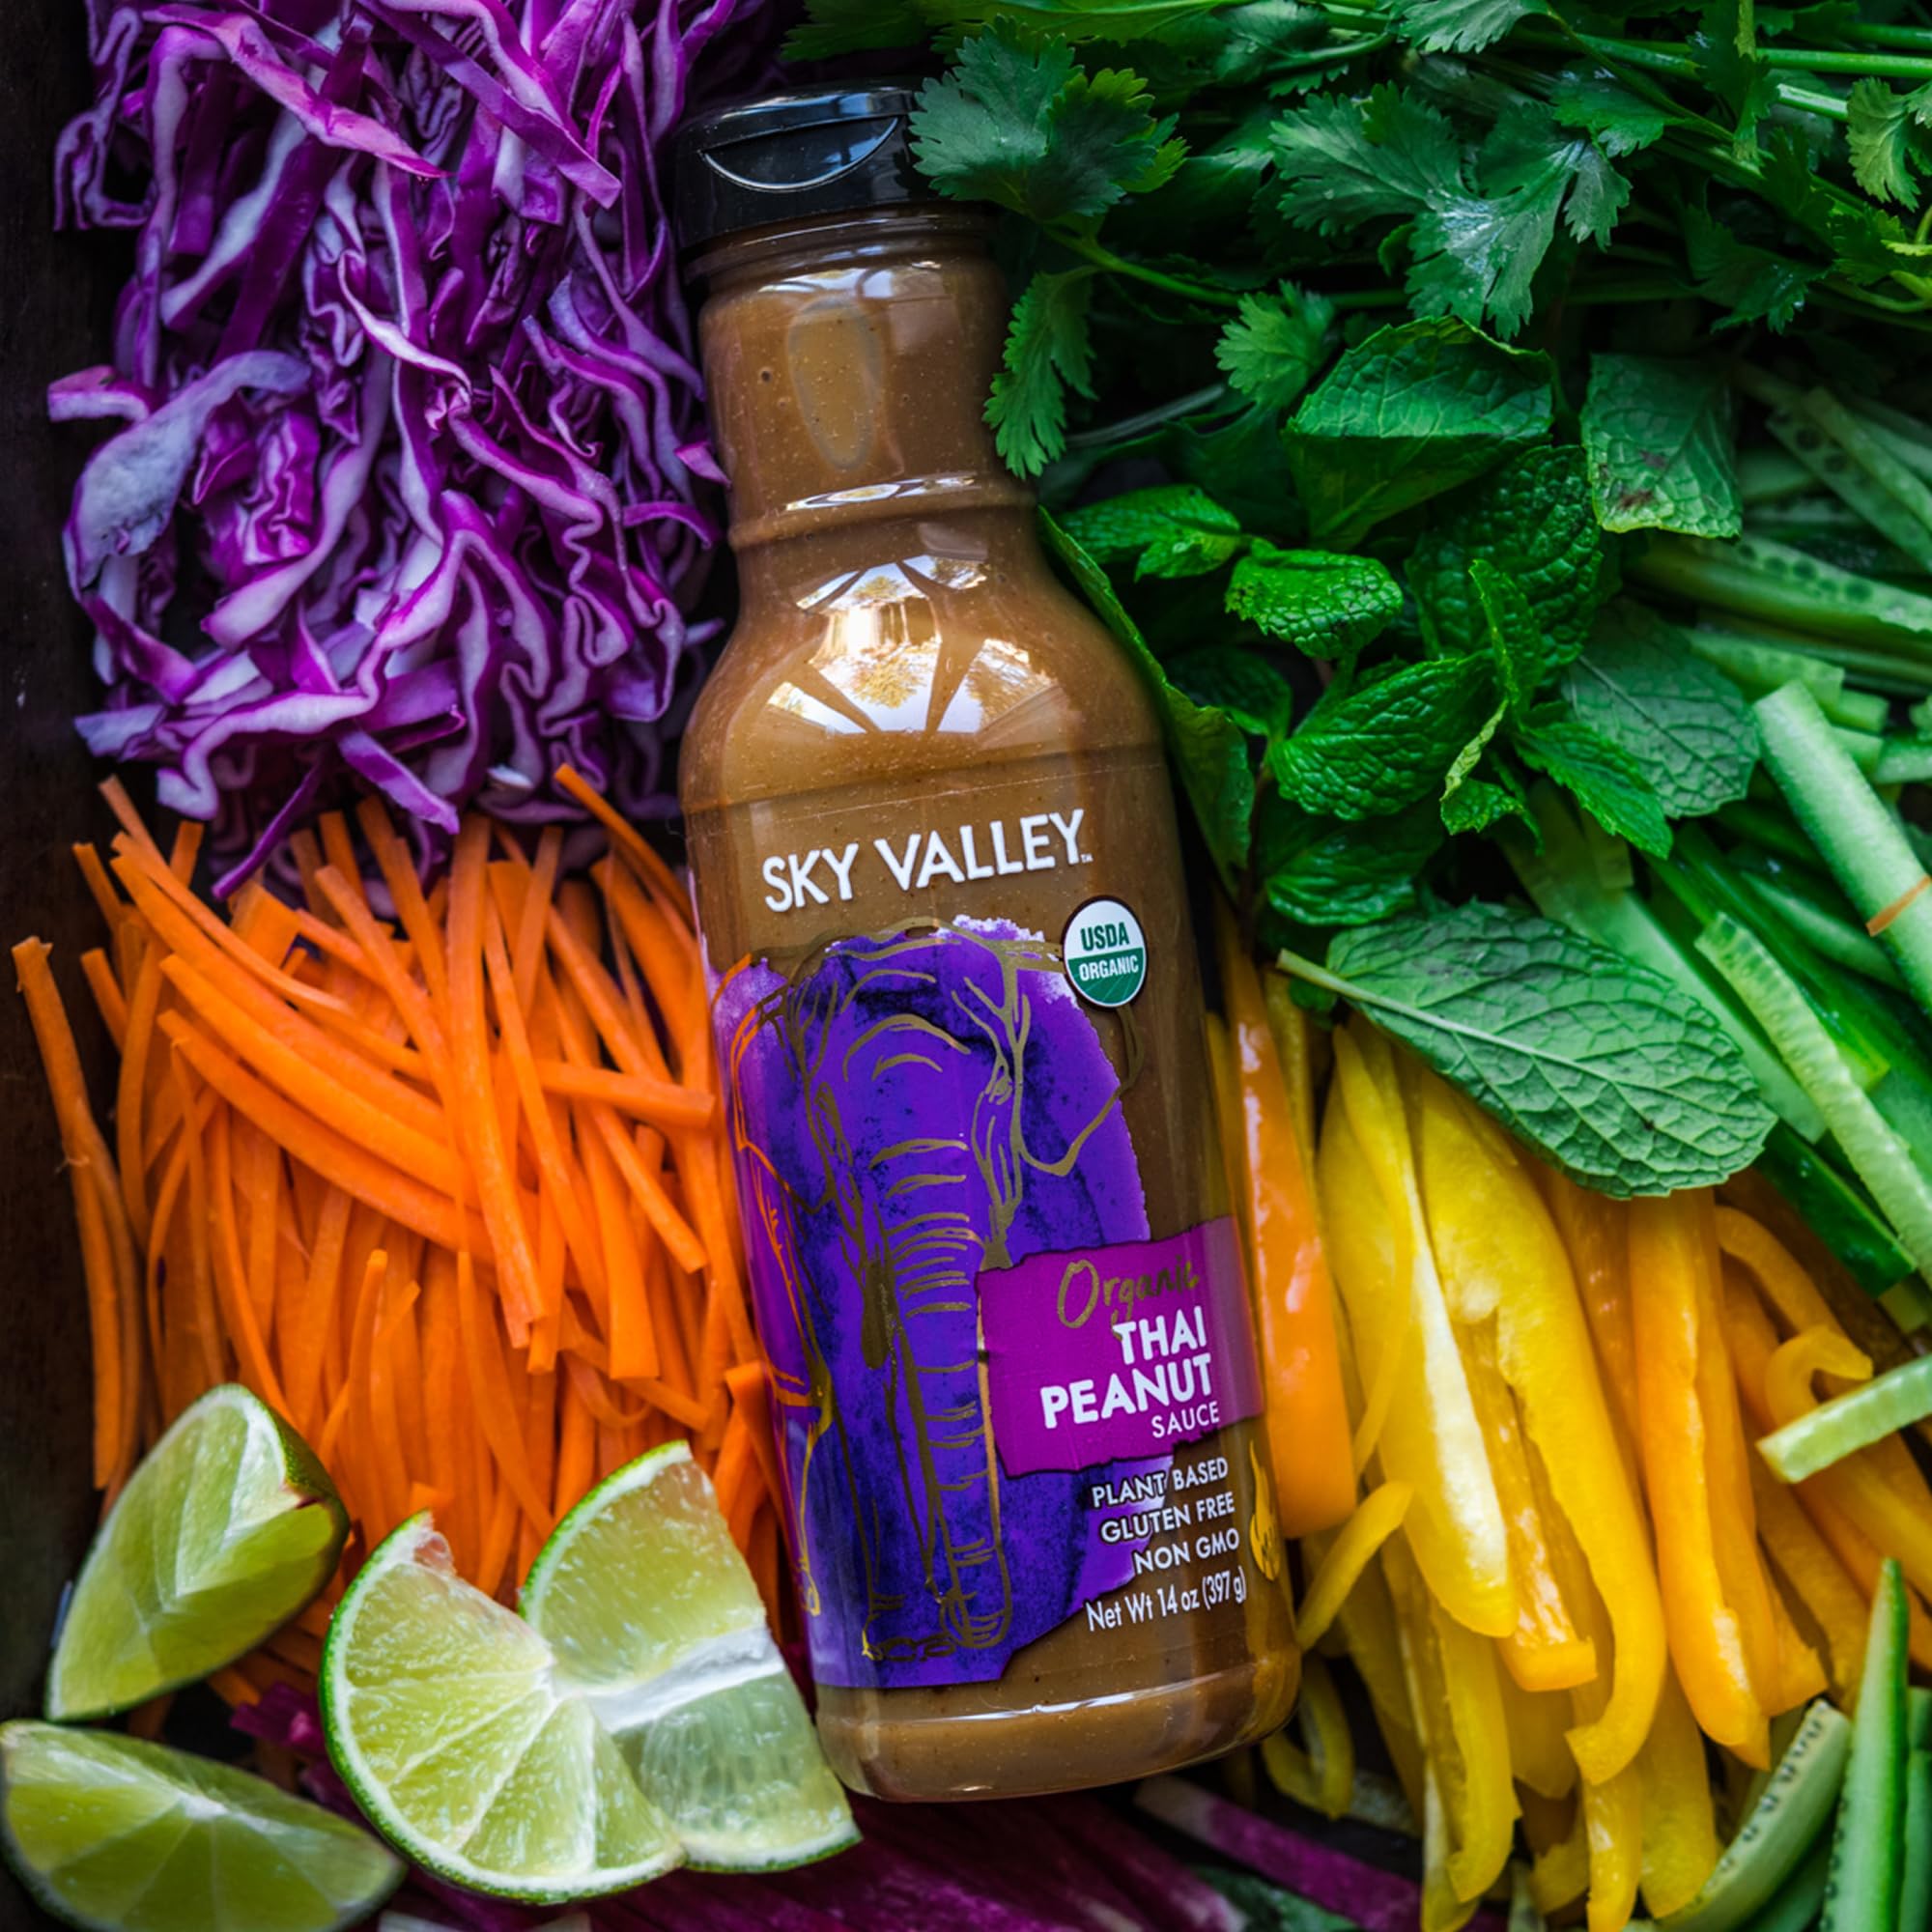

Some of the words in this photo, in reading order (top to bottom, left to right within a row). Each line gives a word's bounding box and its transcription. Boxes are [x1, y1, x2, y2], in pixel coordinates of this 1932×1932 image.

[763, 843, 859, 912] SKY
[874, 809, 1084, 891] VALLEY
[1080, 922, 1129, 952] USDA
[1079, 954, 1139, 981] ORGANIC
[1058, 1256, 1199, 1340] Organic
[1113, 1306, 1207, 1365] THAI
[1040, 1352, 1211, 1429] PEANUT
[1151, 1401, 1219, 1437] SAUCE
[1092, 1473, 1167, 1508] PLANT
[1172, 1457, 1229, 1492] BASED
[1101, 1504, 1191, 1543] GLUTEN
[1196, 1492, 1236, 1522] FREE
[1133, 1542, 1190, 1575] NON
[1196, 1528, 1239, 1559] GMO
[1085, 1601, 1122, 1632] Net
[1124, 1592, 1153, 1624] Wt
[1157, 1584, 1178, 1617] 14
[1180, 1588, 1201, 1612] oz
[1202, 1570, 1231, 1610] (397
[1233, 1565, 1247, 1604] g)
